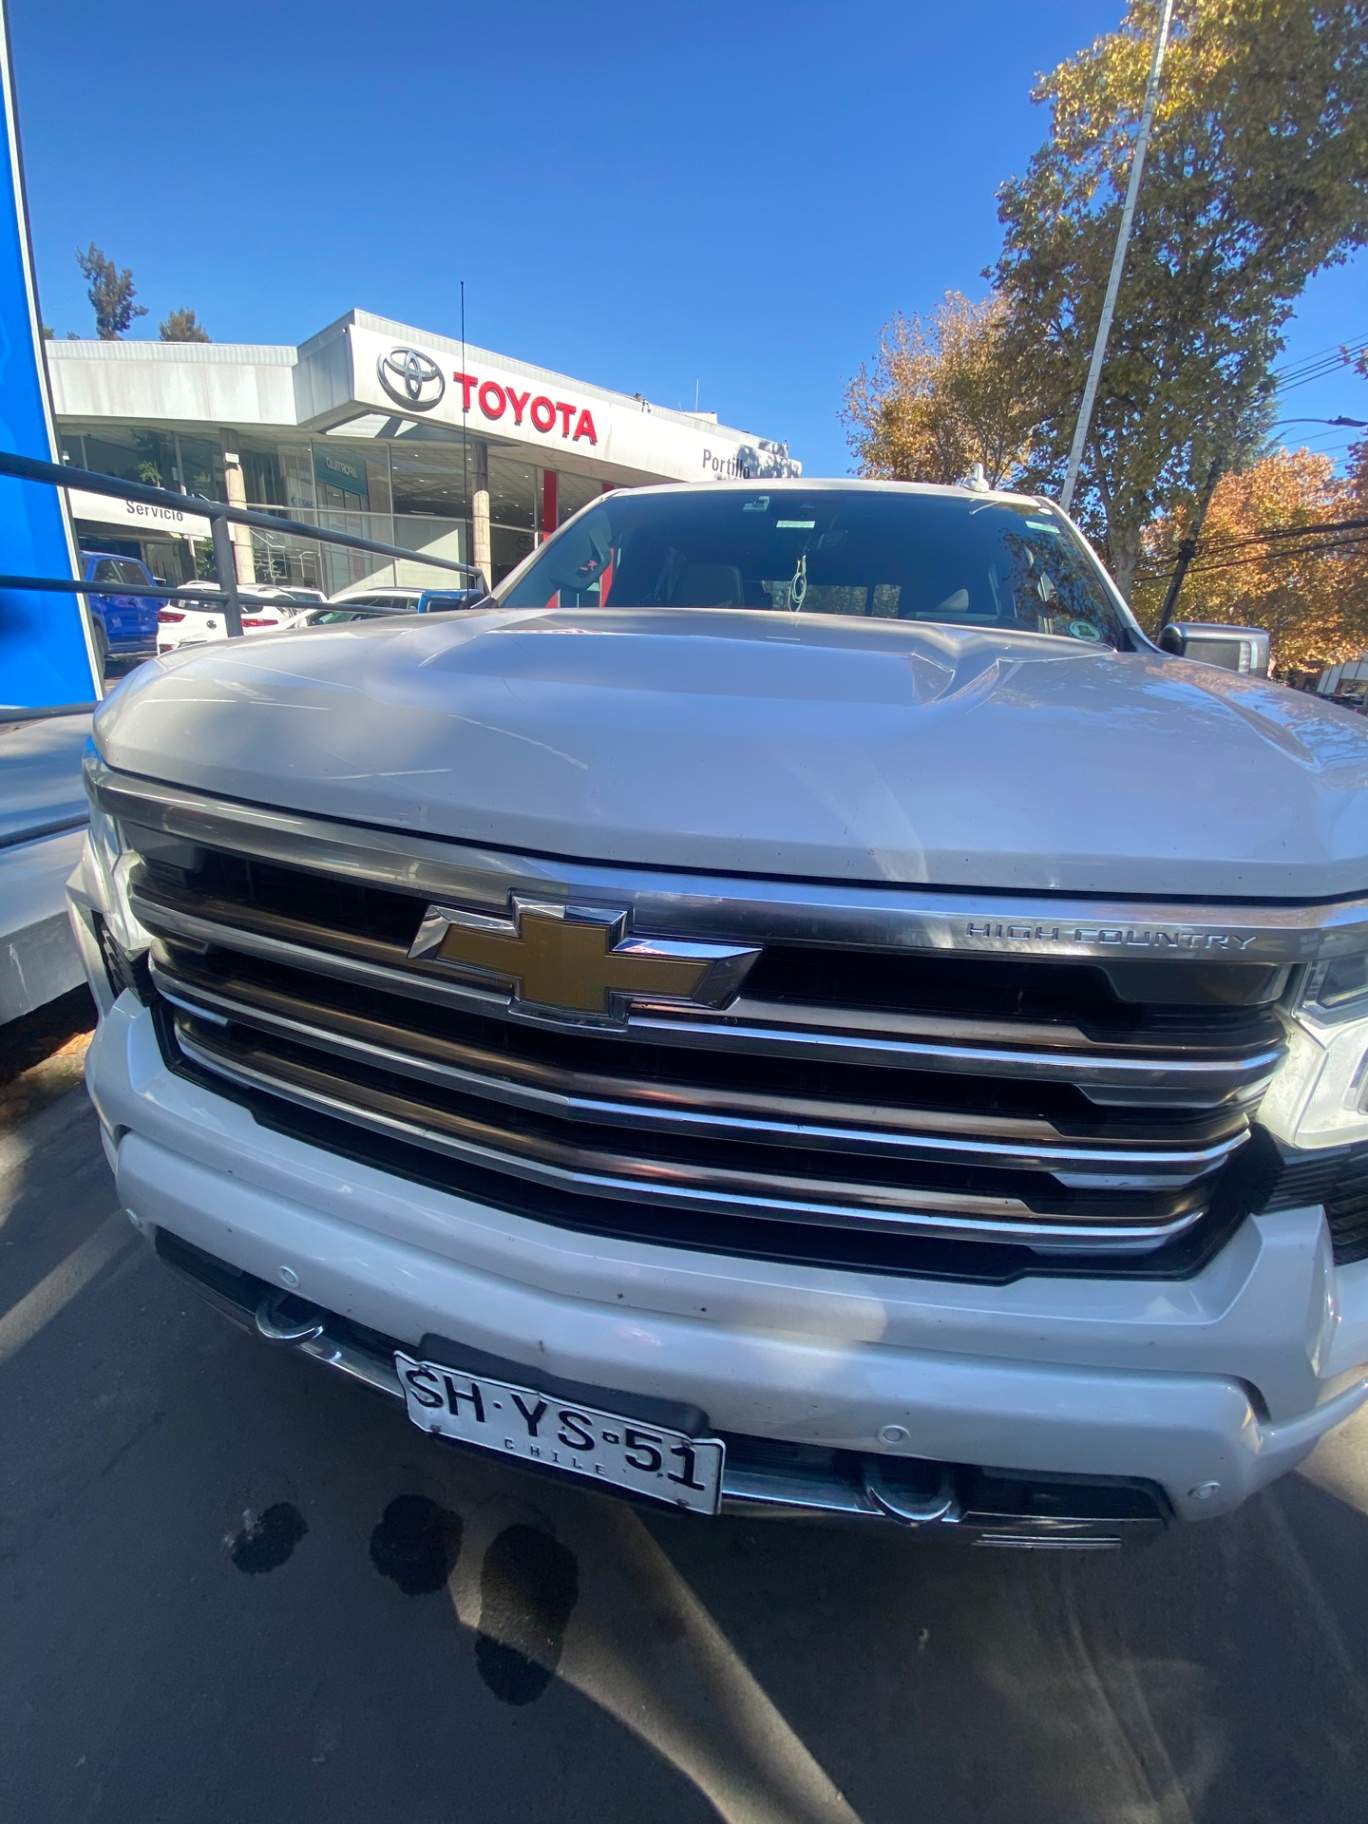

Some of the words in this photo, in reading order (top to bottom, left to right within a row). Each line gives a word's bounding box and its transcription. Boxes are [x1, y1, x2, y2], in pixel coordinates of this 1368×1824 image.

[453, 371, 598, 446] TOYOTA
[703, 448, 751, 480] Portillo
[126, 500, 184, 522] Servicio
[966, 922, 1060, 942] HIGH
[1073, 927, 1257, 950] COUNTRY
[503, 1438, 608, 1478] CHILE
